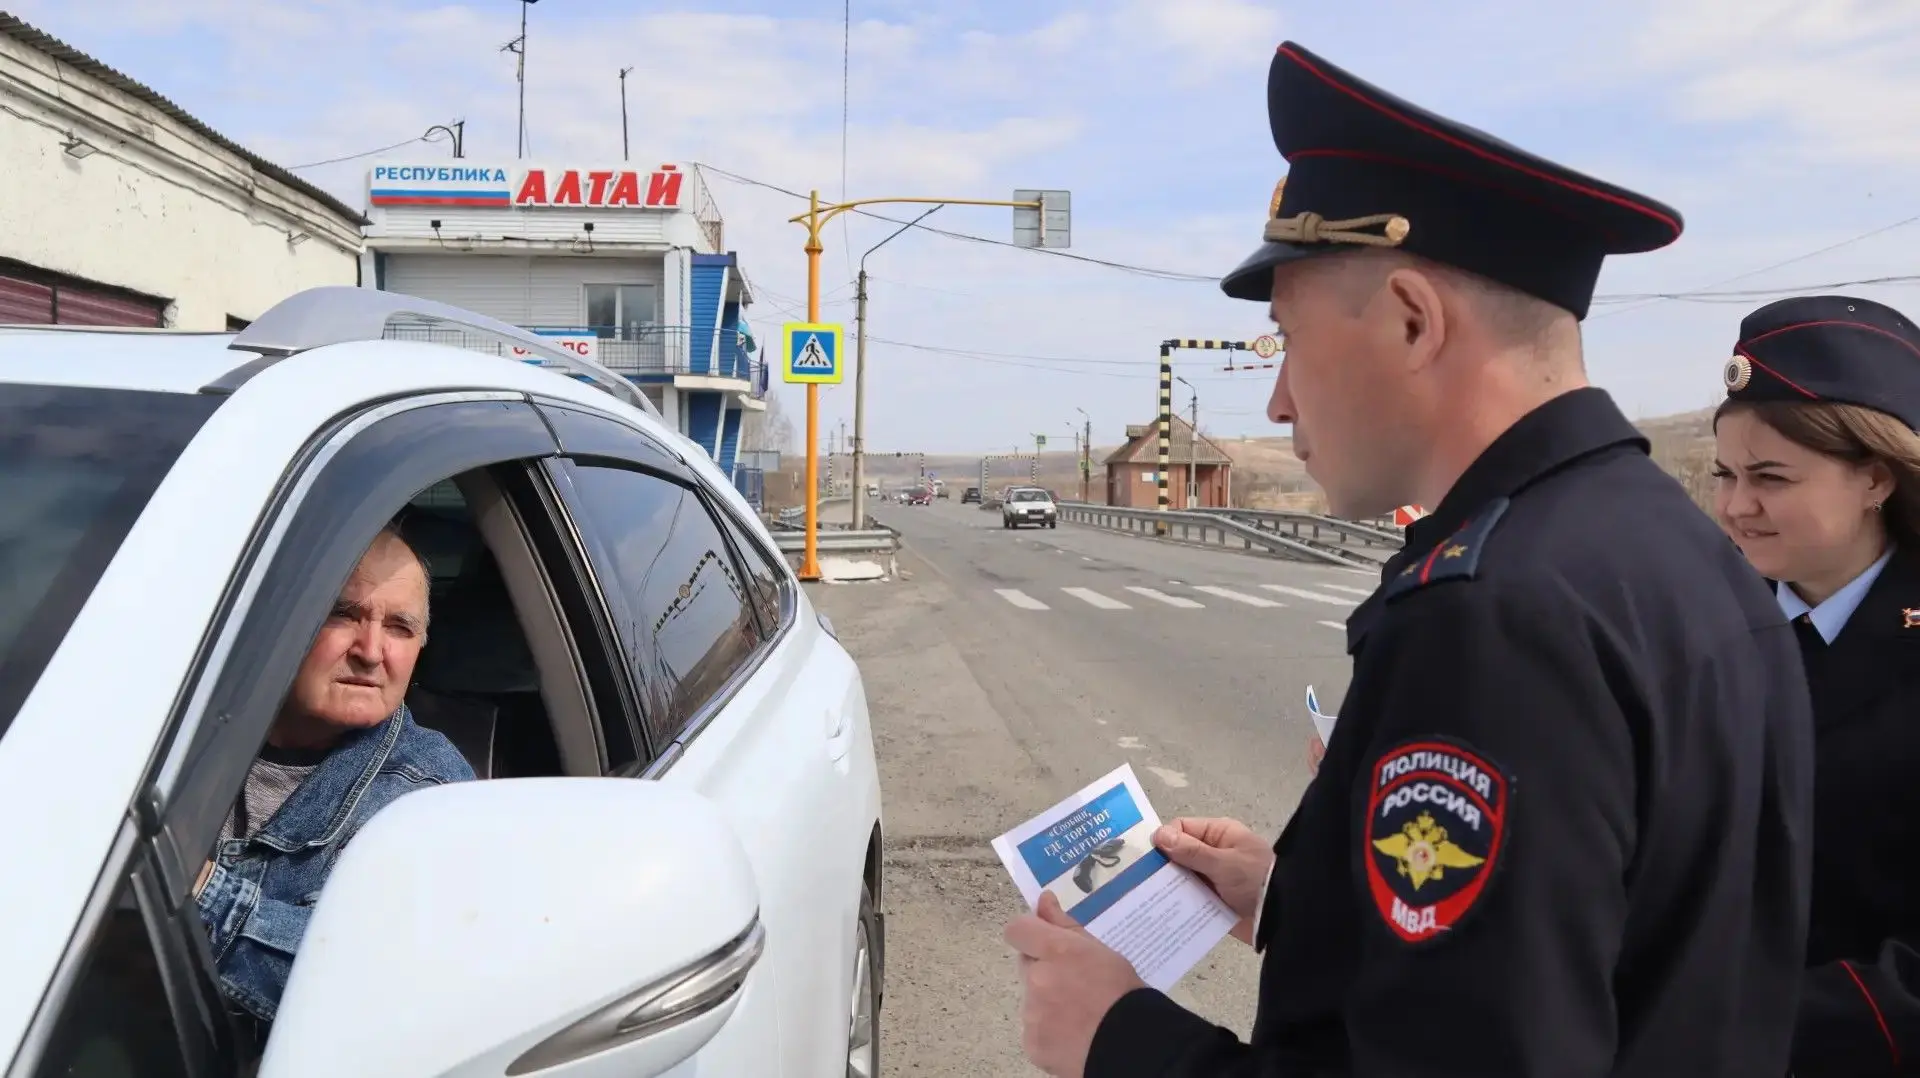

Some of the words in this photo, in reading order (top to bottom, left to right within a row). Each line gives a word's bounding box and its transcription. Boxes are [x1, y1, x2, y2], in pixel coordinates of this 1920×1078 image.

[375, 167, 506, 182] РЕСПУБЛИКА
[515, 164, 683, 206] АЛТАЙ
[1380, 751, 1491, 799] ПОЛИЦИЯ
[1381, 782, 1481, 831] РОССИЯ
[1043, 840, 1064, 857] ГДЕ
[1063, 808, 1111, 844] ТОРГУЮТ
[1391, 896, 1437, 934] МВД
